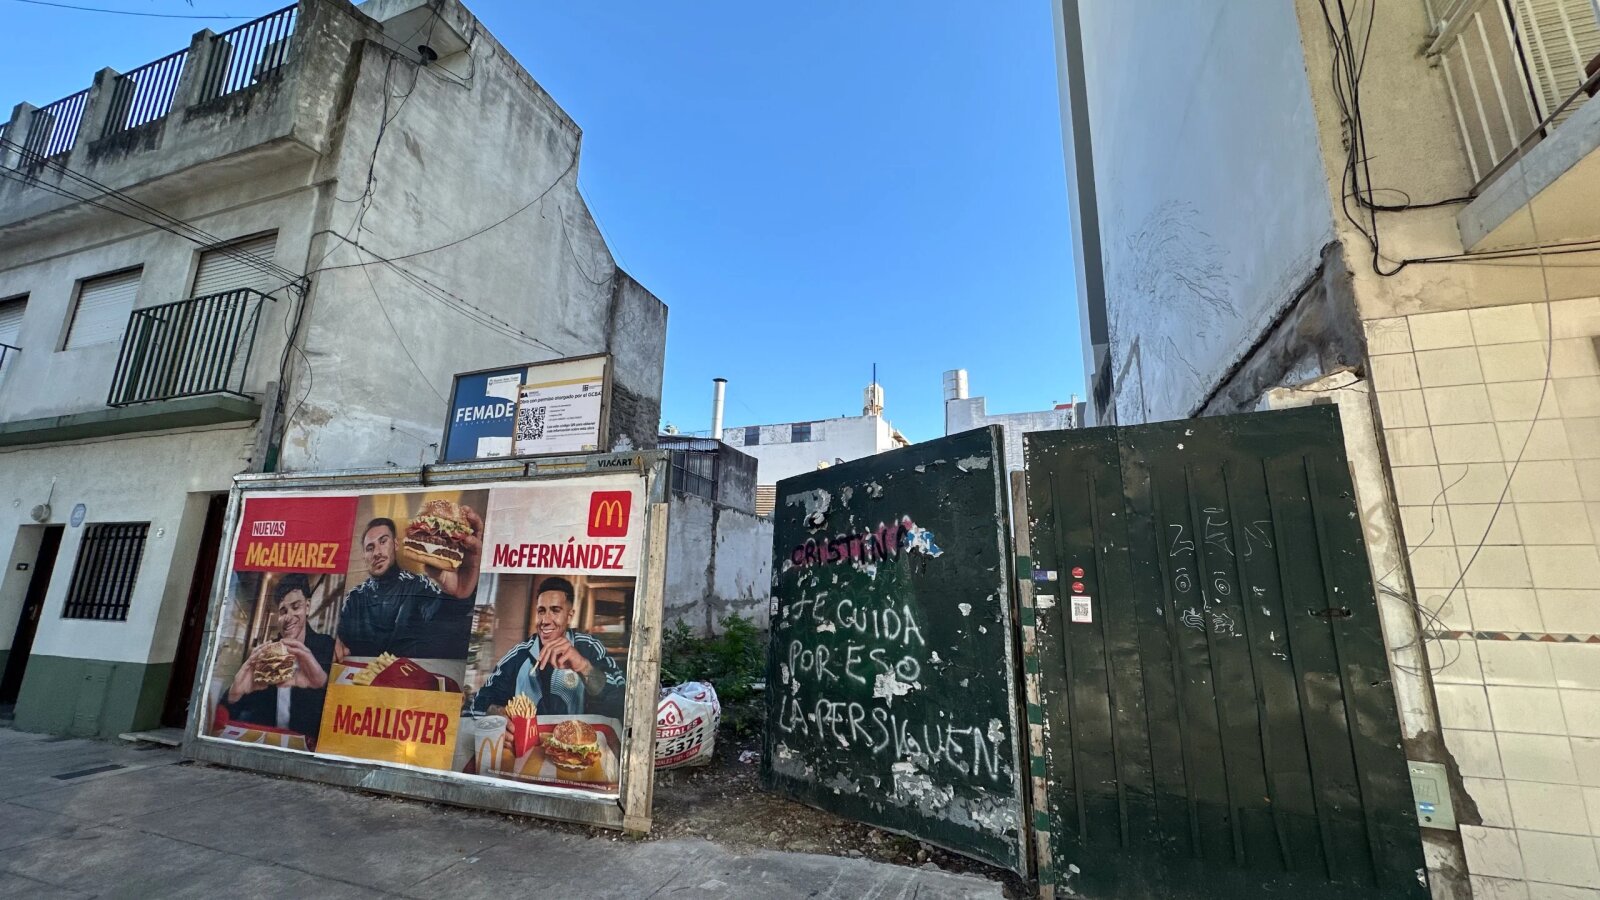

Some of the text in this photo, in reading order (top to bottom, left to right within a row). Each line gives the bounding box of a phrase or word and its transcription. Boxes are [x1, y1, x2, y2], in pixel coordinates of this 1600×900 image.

[456, 402, 515, 423] FEMADE
[597, 458, 633, 468] VIACART
[252, 522, 285, 536] NUEVAS
[244, 541, 340, 569] McALVAREZ
[492, 536, 626, 570] McFERNÁNDEZ
[789, 640, 920, 684] POR ESO
[332, 704, 449, 746] McALLISTER
[656, 720, 698, 738] ERIALES
[779, 695, 809, 736] LA
